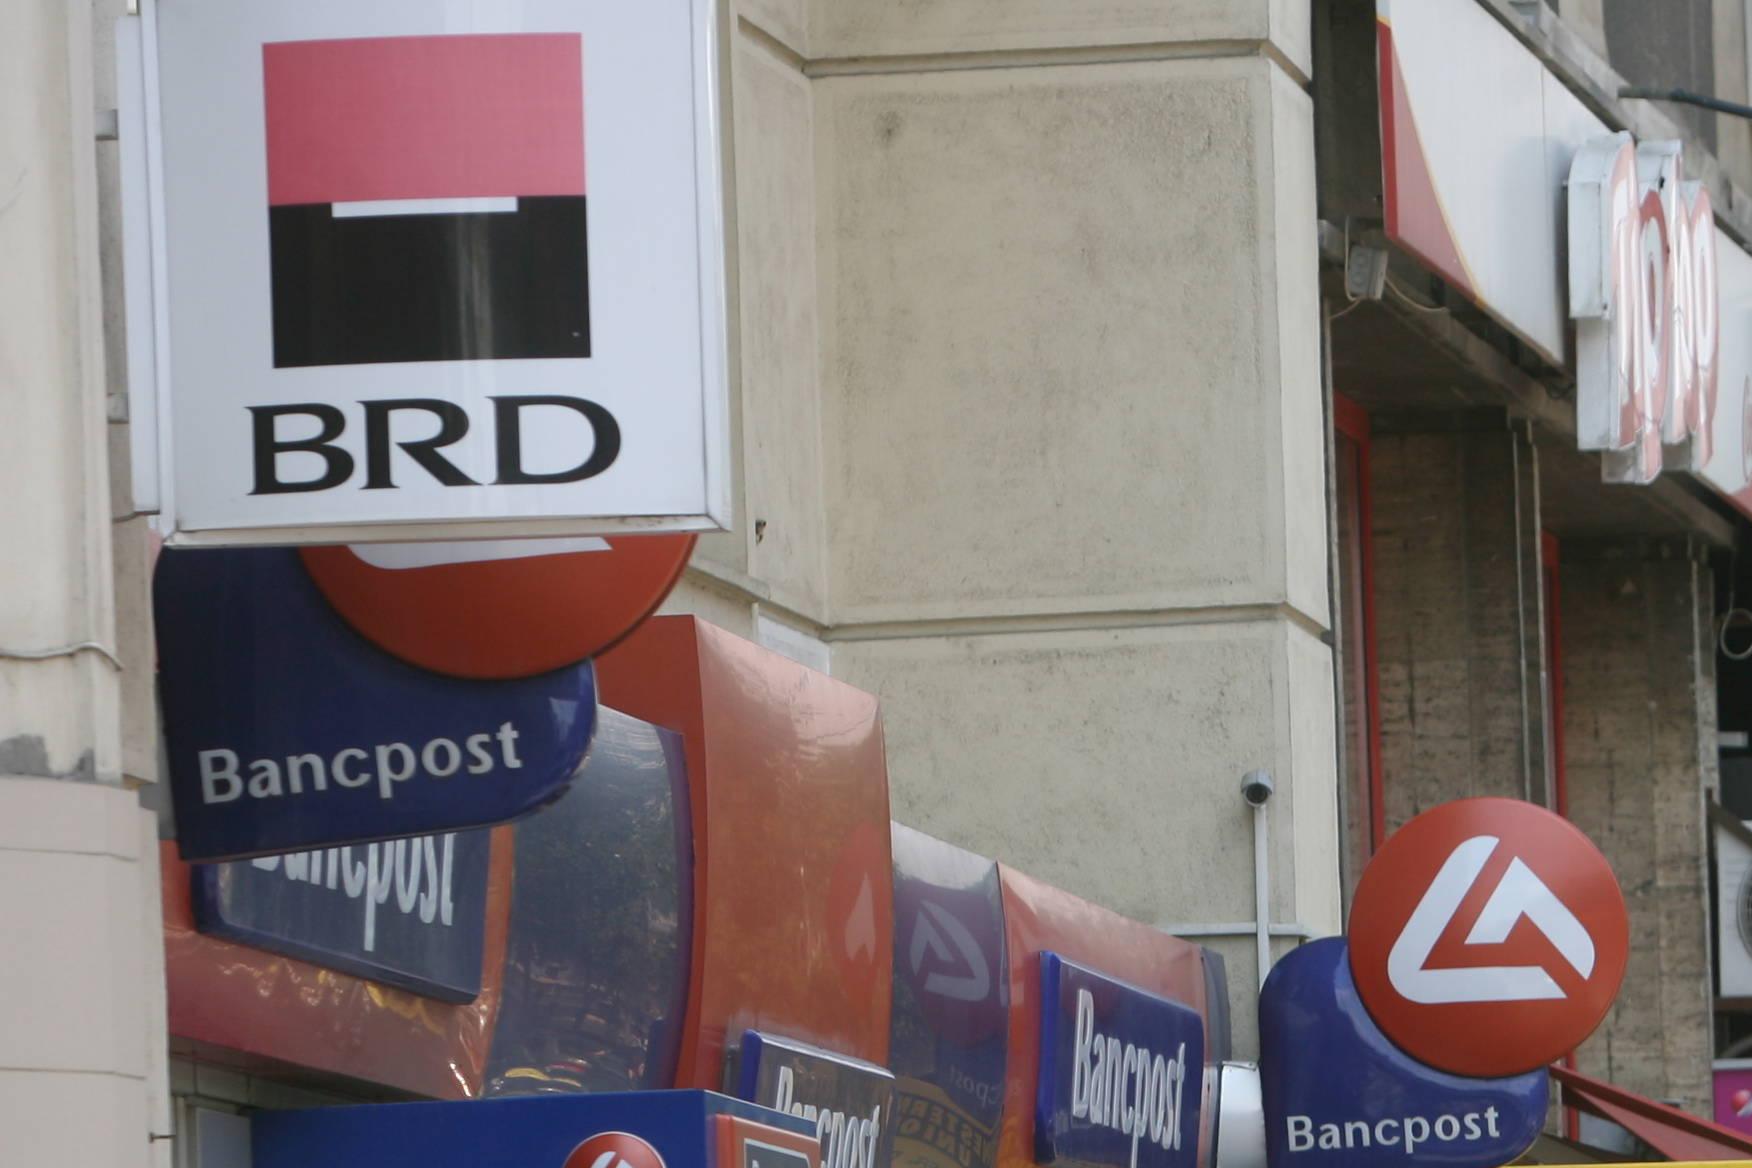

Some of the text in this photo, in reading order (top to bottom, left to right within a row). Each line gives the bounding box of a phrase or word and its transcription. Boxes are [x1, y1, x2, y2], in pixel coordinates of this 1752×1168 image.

[245, 394, 622, 496] BRD
[198, 721, 523, 804] Bancpost
[251, 833, 457, 952] ncpost
[1286, 1104, 1501, 1153] Bancpost
